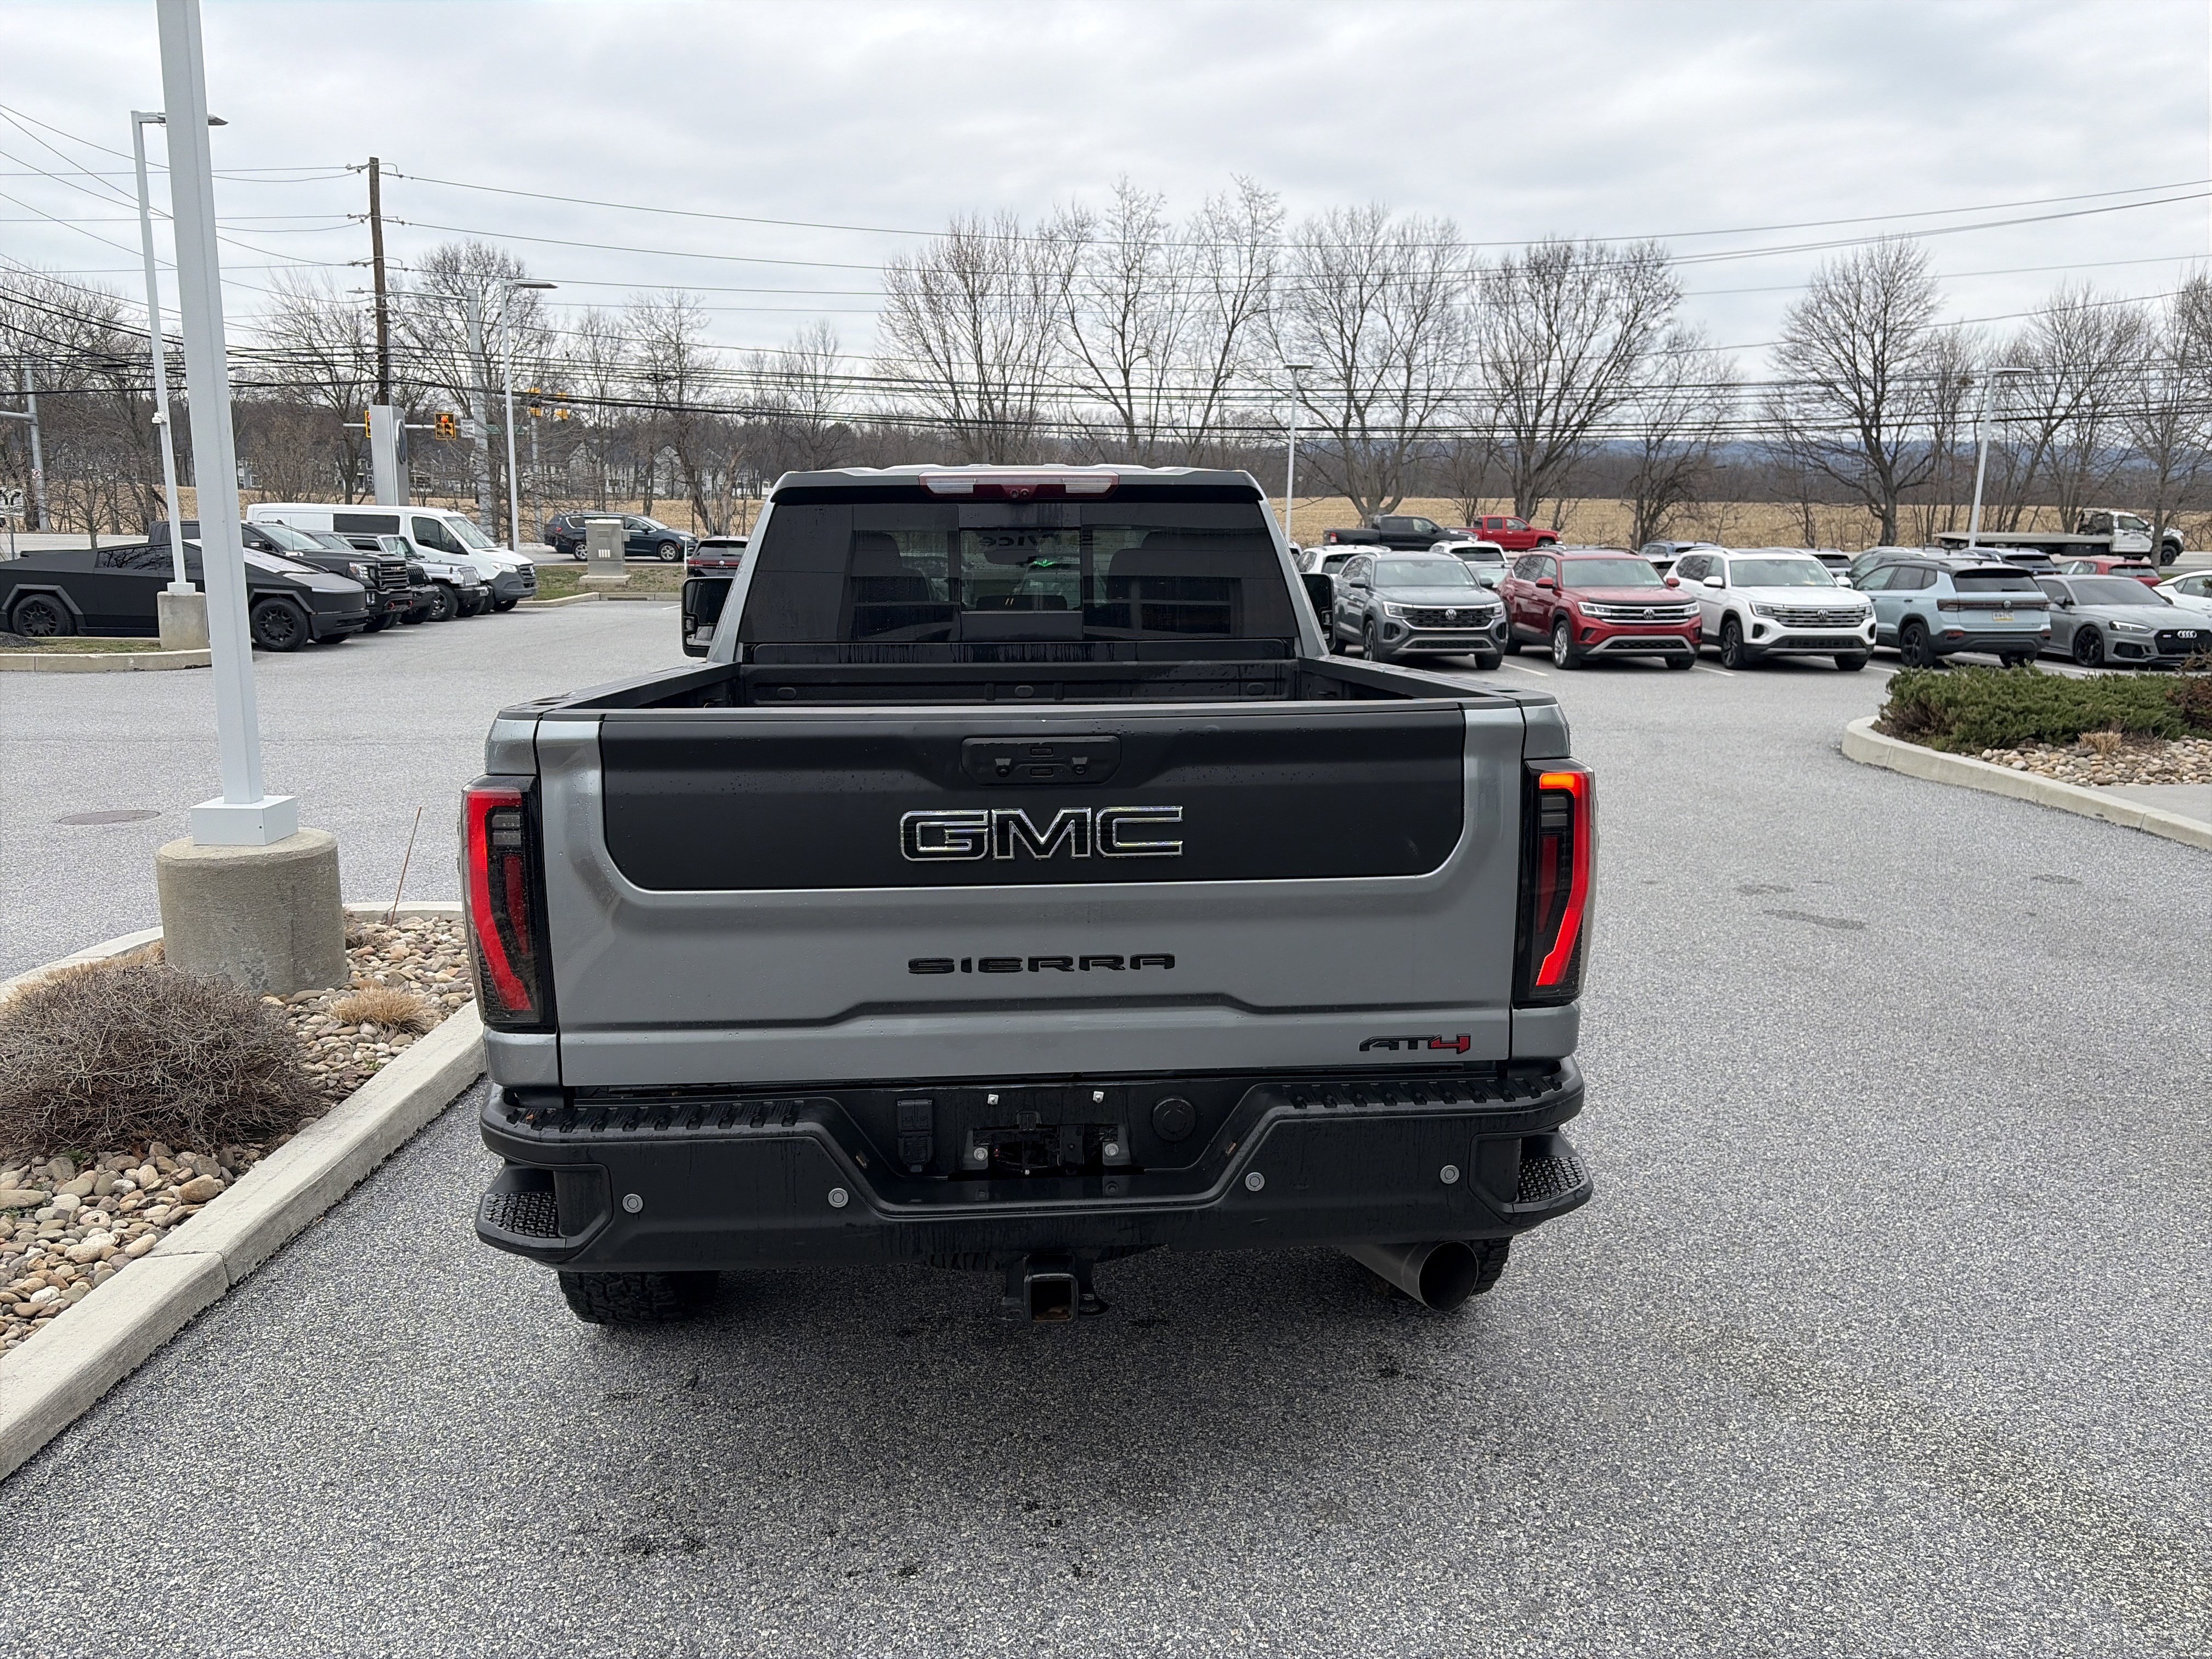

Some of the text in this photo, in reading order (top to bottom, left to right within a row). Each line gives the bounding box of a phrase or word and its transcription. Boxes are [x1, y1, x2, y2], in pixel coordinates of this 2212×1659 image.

[900, 806, 1183, 861] GMC
[908, 953, 1175, 974] SIERRA
[1359, 1033, 1471, 1054] AT4
